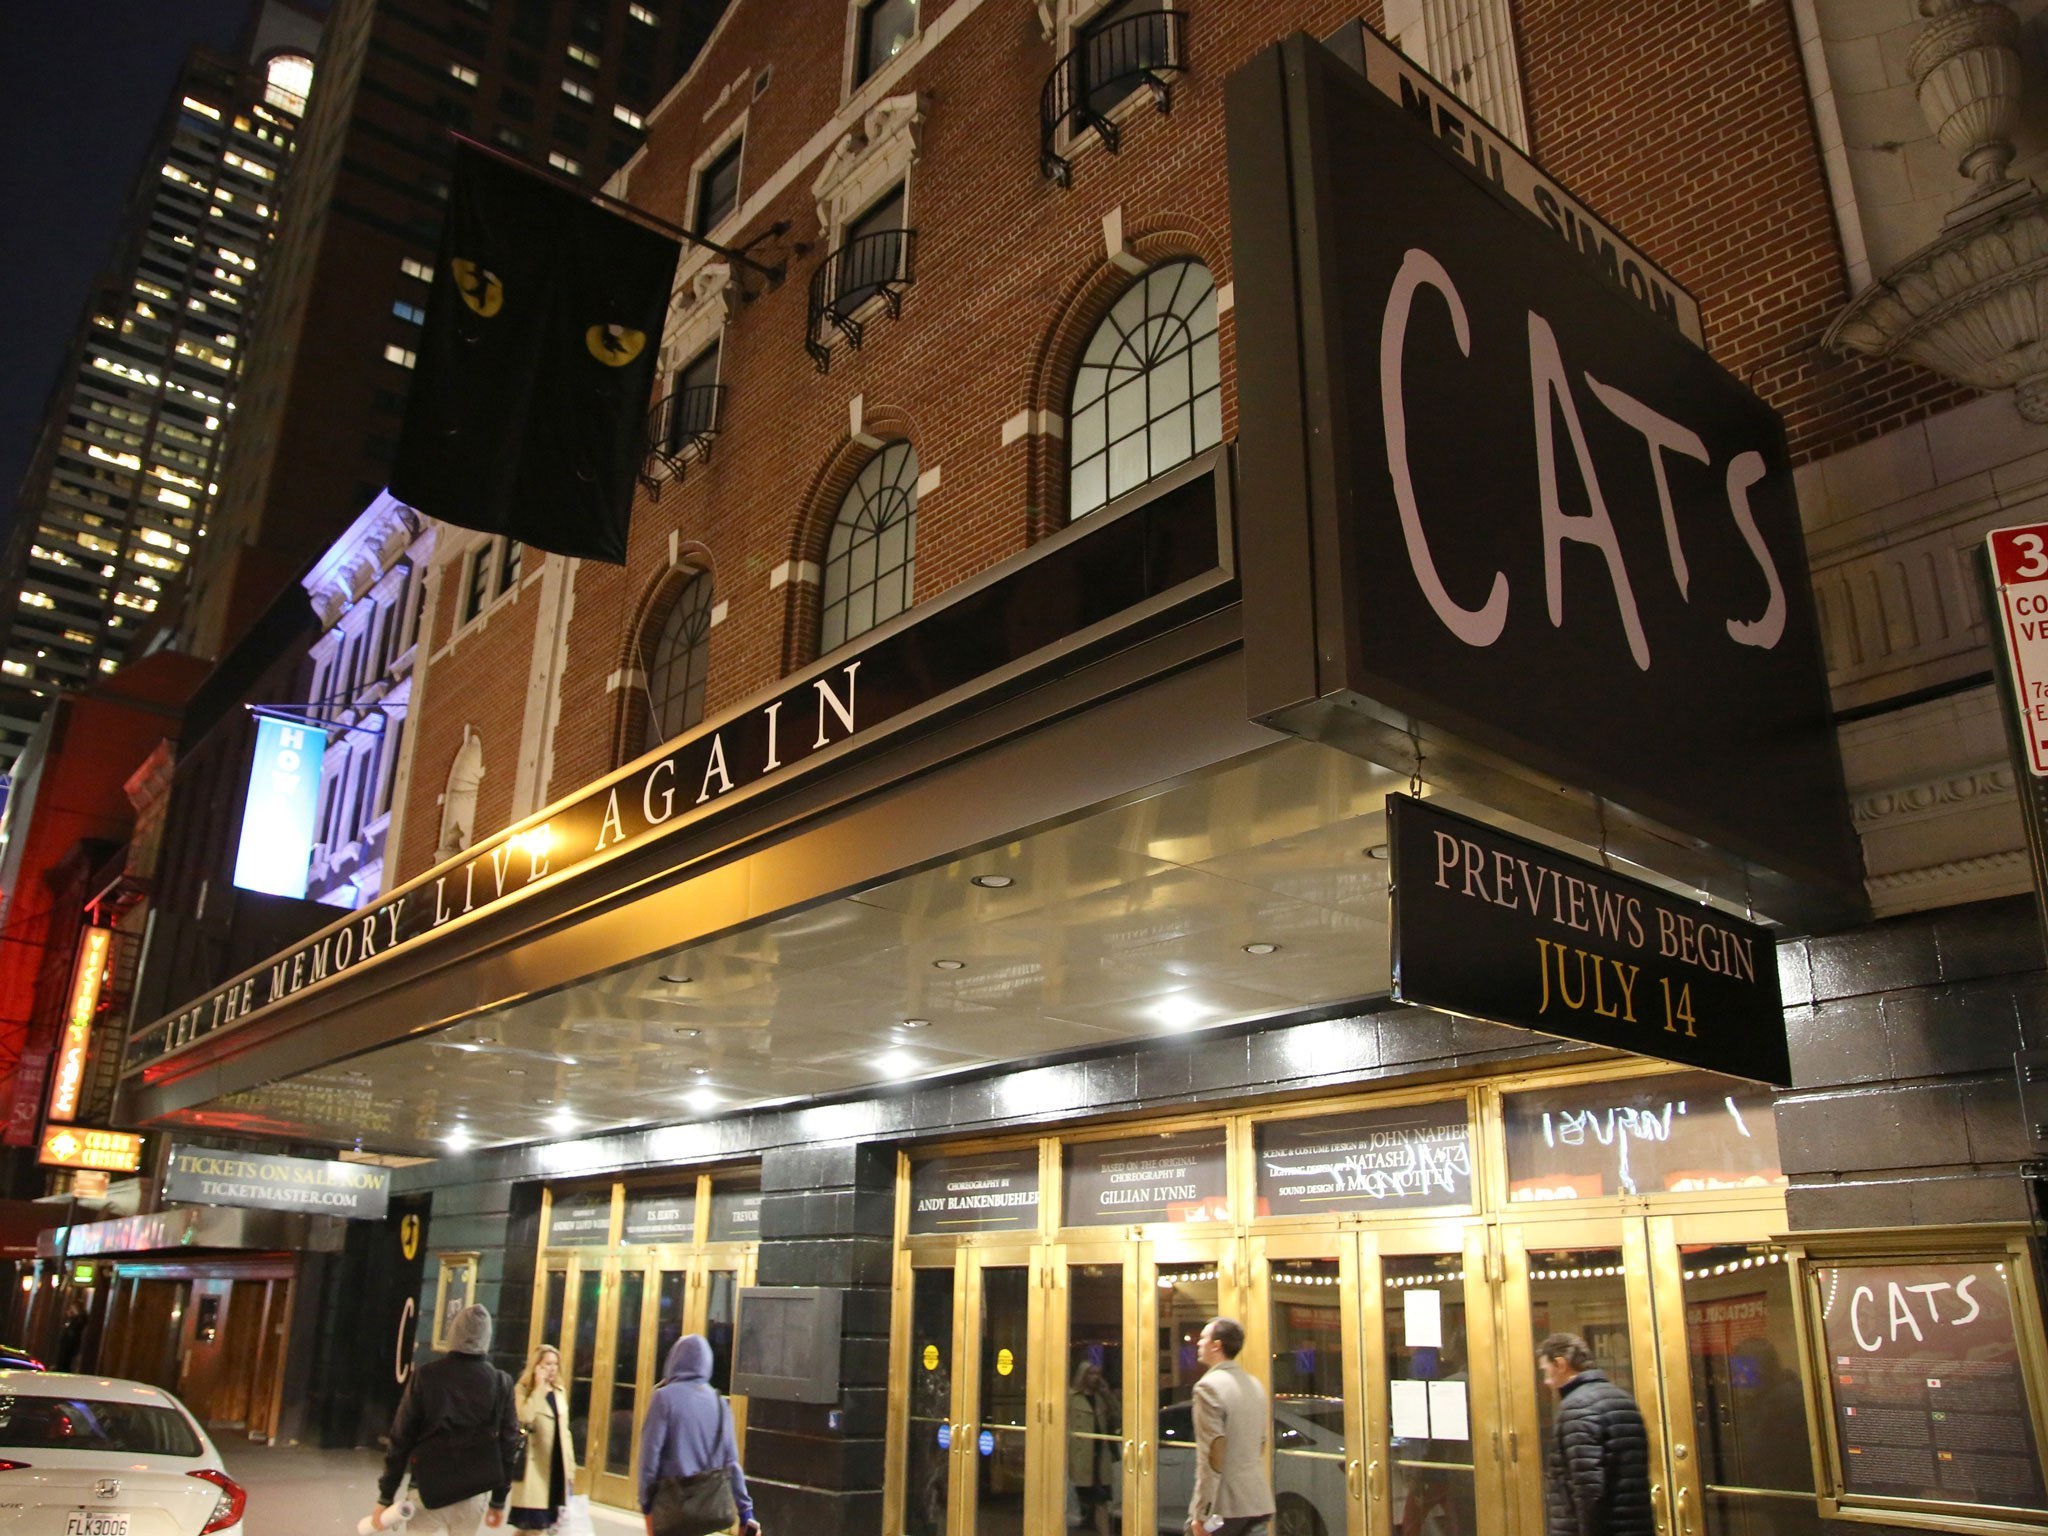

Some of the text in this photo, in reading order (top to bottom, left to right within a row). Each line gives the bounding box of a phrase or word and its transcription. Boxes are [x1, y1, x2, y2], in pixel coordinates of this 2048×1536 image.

[1381, 248, 1786, 671] CATS
[165, 1006, 202, 1053] LET
[212, 977, 255, 1029] THE
[268, 899, 406, 1003] MEMORY
[595, 661, 861, 851] AGAIN
[1433, 830, 1756, 984] PREVIEWS BEGIN
[1536, 937, 1697, 1038] JULY 14
[1263, 1149, 1287, 1159] SCENIC
[1295, 1145, 1330, 1156] COSTUME
[1331, 1142, 1357, 1152] DESIGN
[1369, 1129, 1410, 1151] JOHN
[1413, 1124, 1470, 1144] NAPIER
[178, 1155, 257, 1178] TICKETS
[260, 1163, 290, 1182] ON
[293, 1169, 337, 1187] SALE
[1101, 1163, 1125, 1173] BASED
[1141, 1160, 1156, 1170] THE
[1158, 1156, 1197, 1168] ORIGINAL
[1110, 1168, 1187, 1183] CHOREOGRAPHY BY
[201, 1180, 357, 1207] TICKETMASTER.COM
[1100, 1184, 1197, 1205] GILLIAN LYNNE
[1279, 1185, 1305, 1196] SOUND
[1307, 1184, 1334, 1195] DESIGN
[917, 1198, 946, 1212] ANDY
[1851, 1275, 1980, 1351] CATS
[67, 1519, 128, 1536] FLK3006
